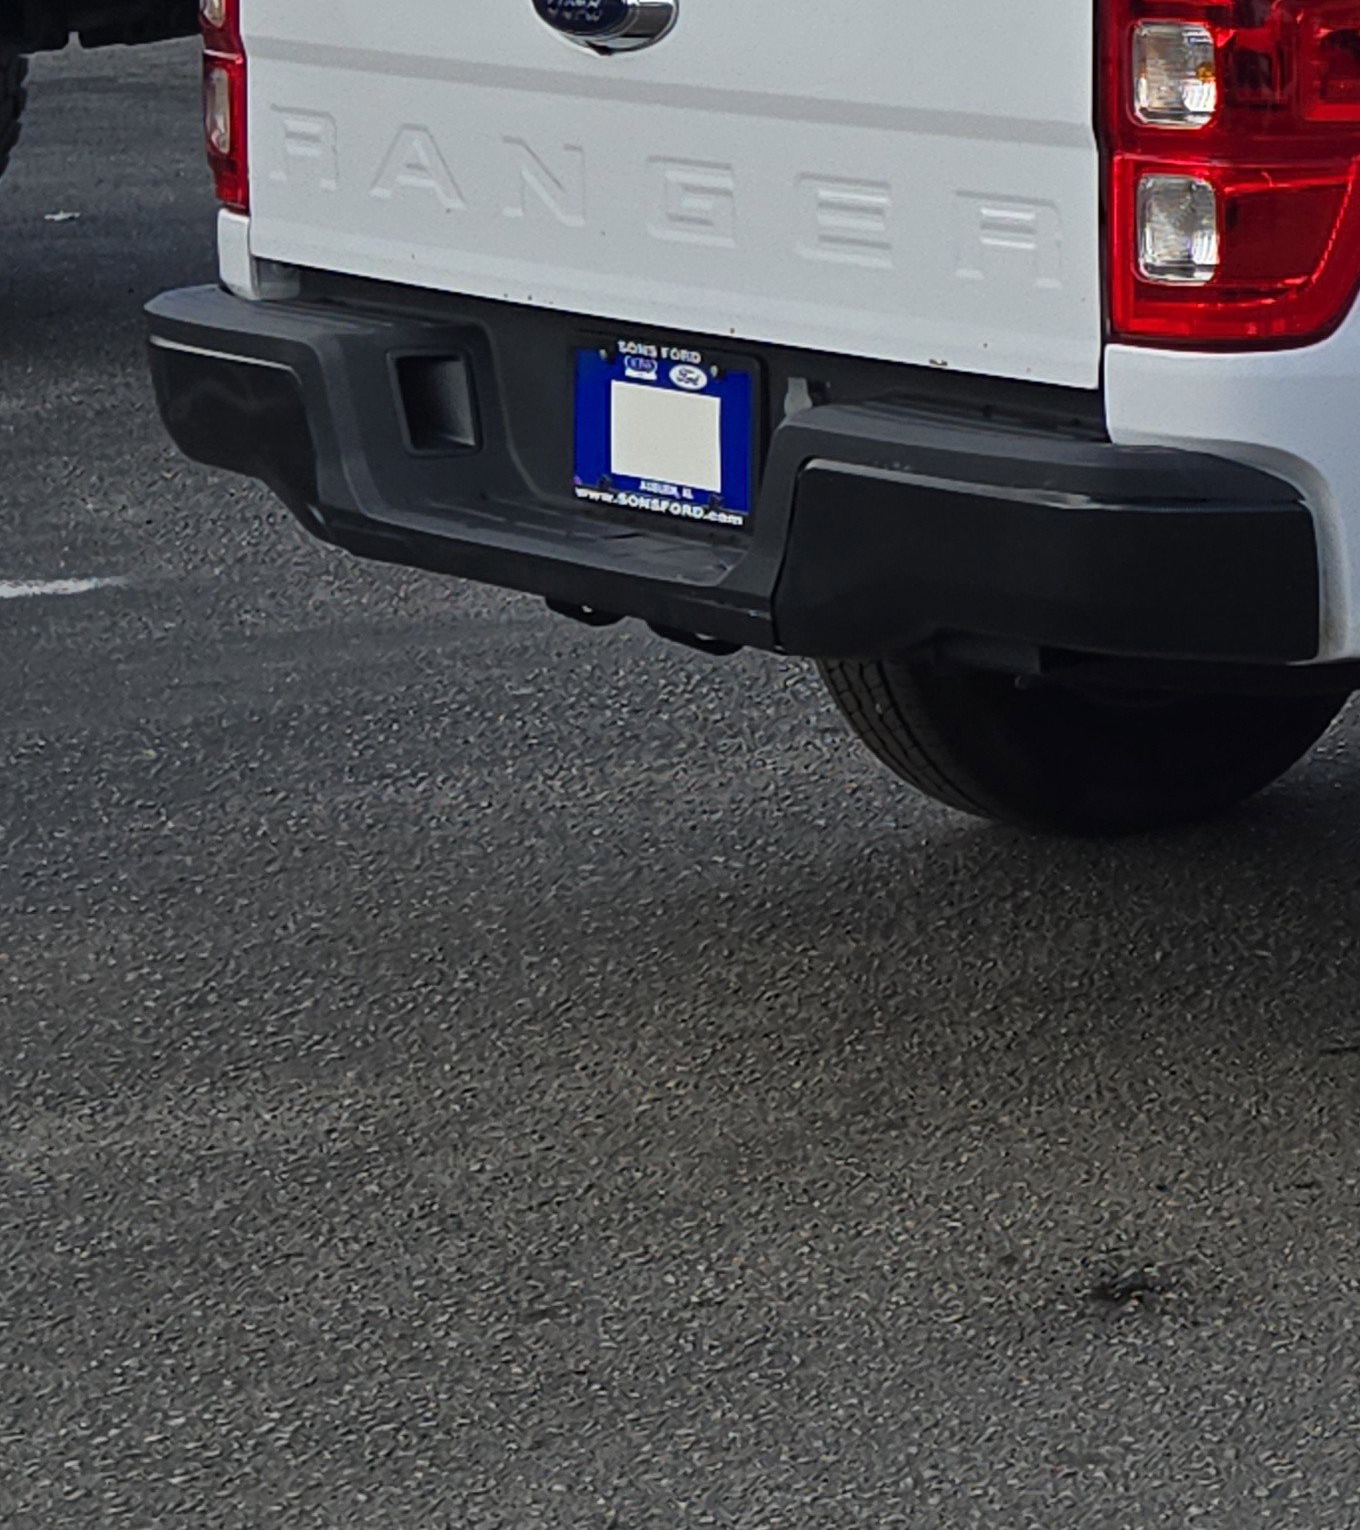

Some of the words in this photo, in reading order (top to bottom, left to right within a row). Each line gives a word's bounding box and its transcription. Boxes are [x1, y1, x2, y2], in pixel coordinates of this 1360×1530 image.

[269, 102, 1063, 289] RANGER
[617, 339, 658, 359] SONS
[660, 346, 702, 364] FORD
[574, 487, 744, 526] www.SONSFORD.com
